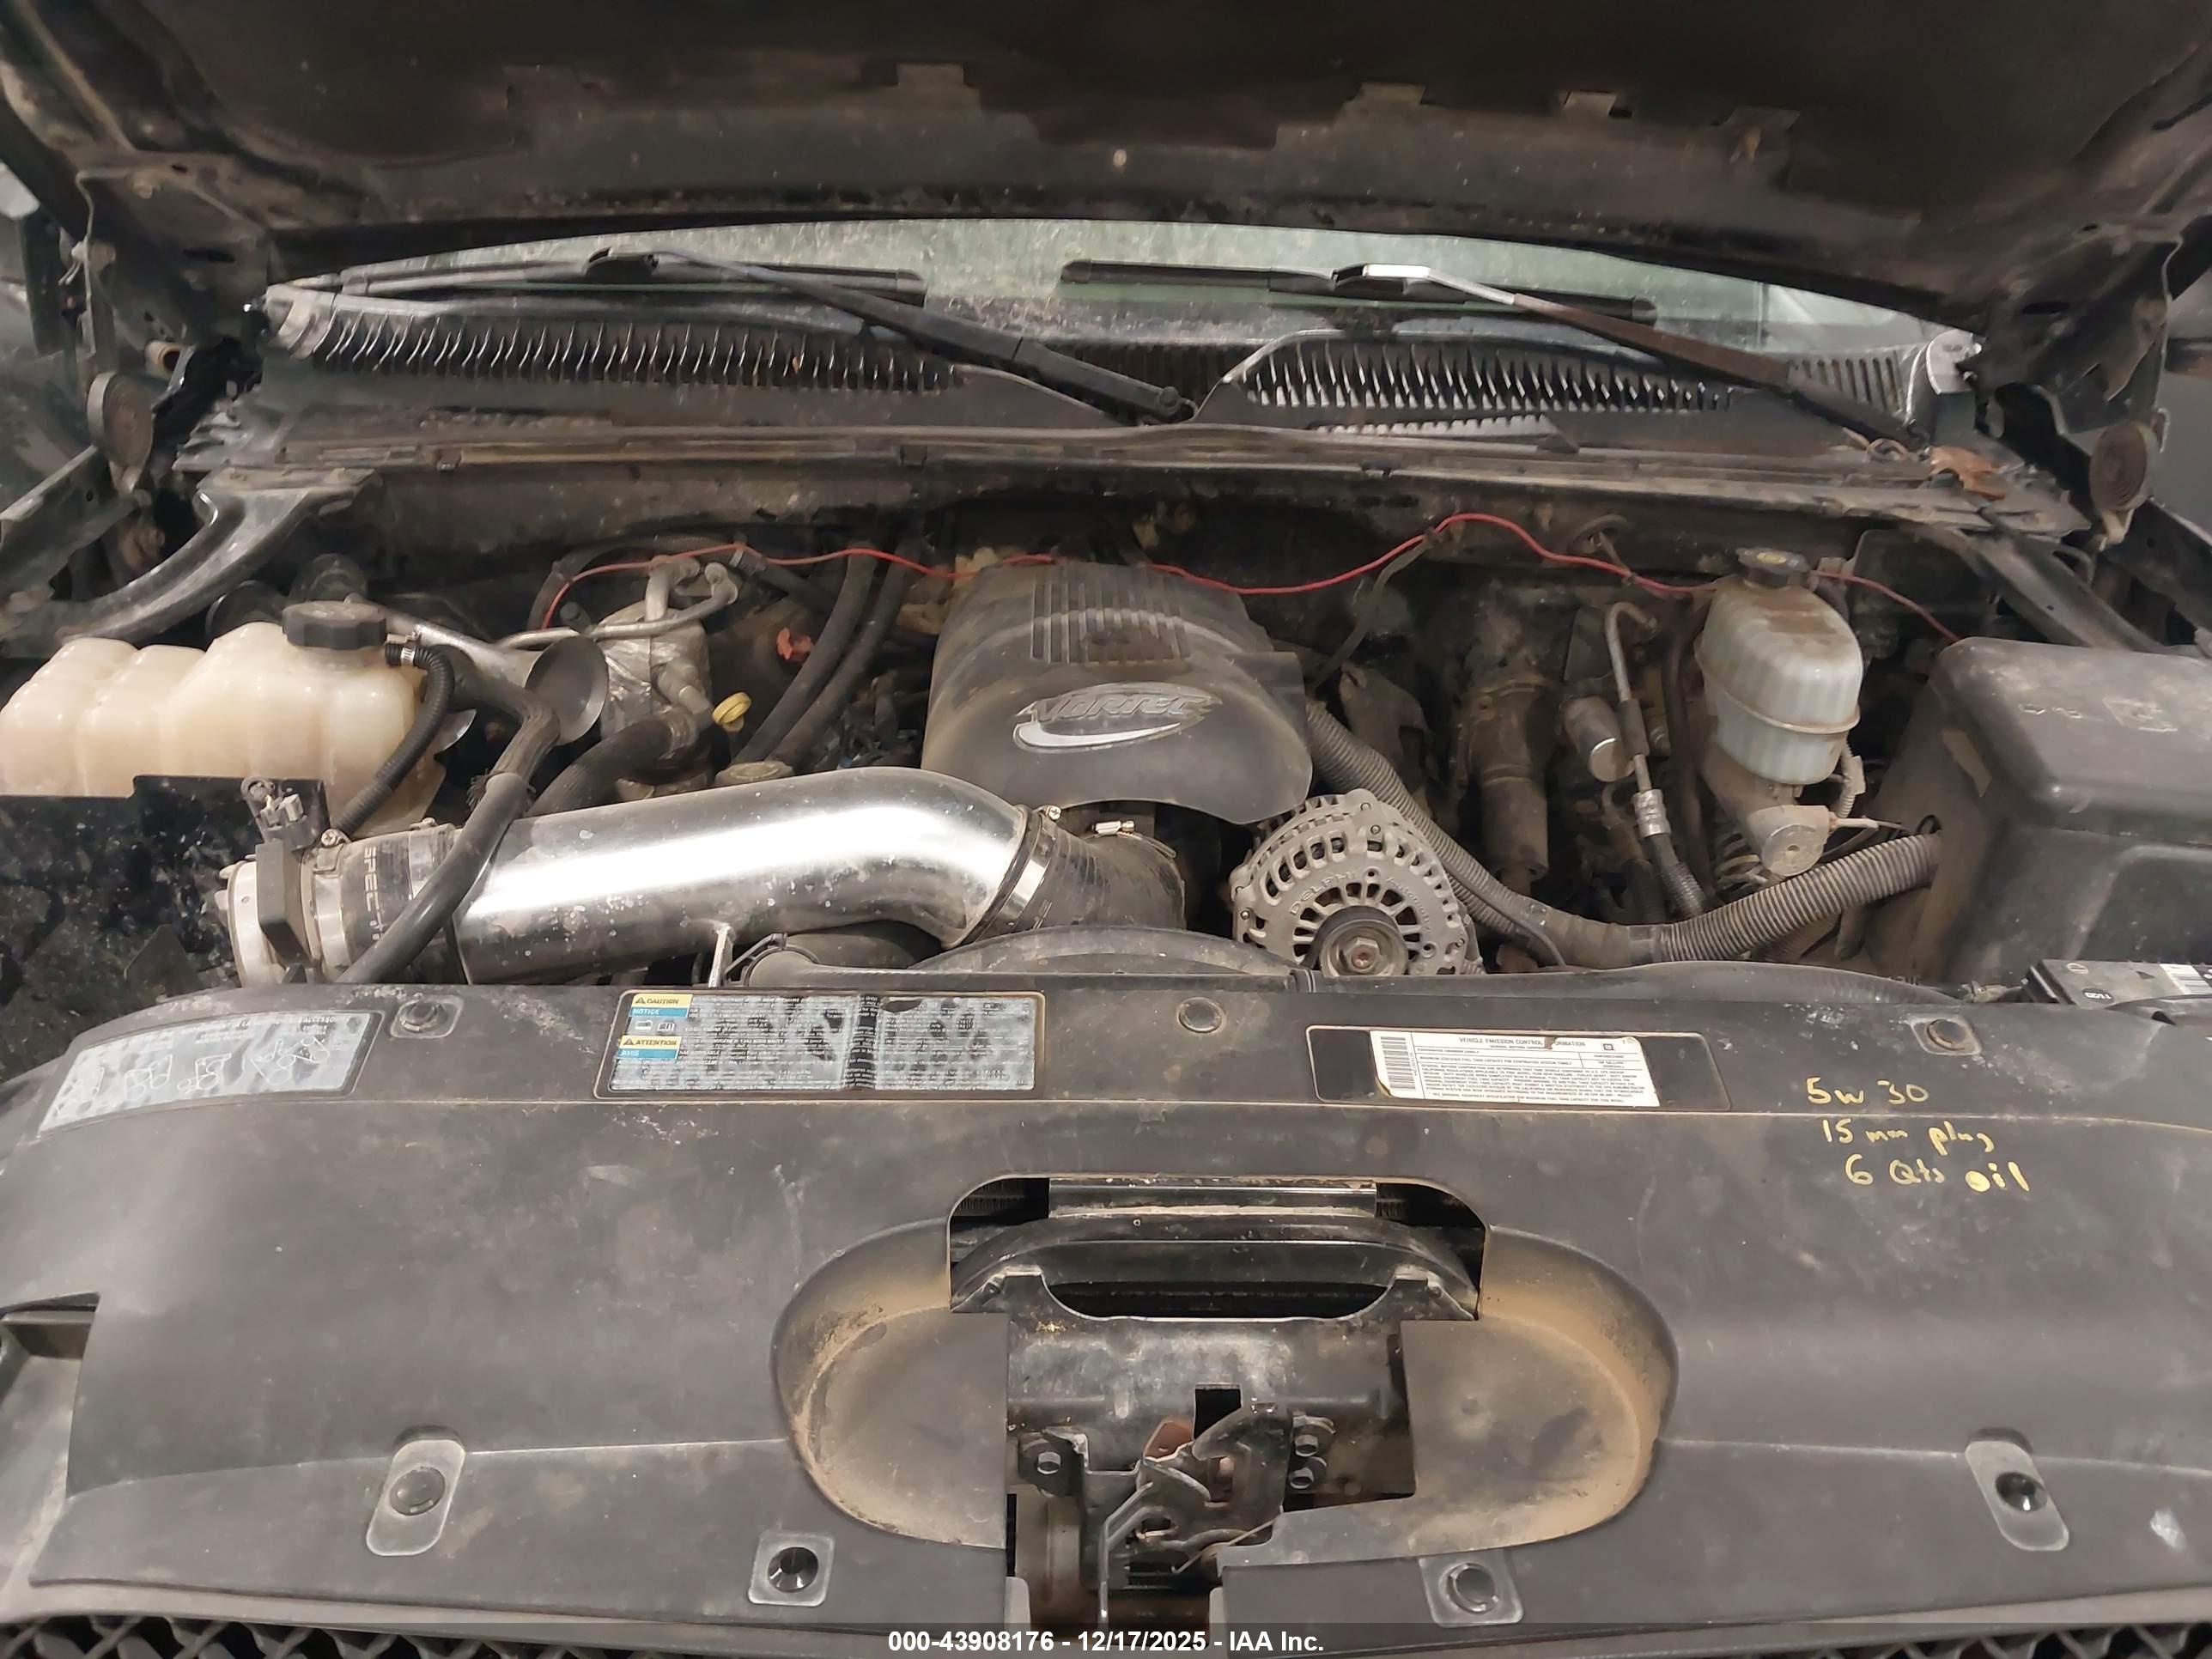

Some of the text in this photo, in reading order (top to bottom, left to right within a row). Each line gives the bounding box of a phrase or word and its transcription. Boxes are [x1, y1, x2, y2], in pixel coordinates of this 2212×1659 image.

[1030, 691, 1211, 724] VORTEC
[1877, 1079, 1929, 1105] 30
[1821, 1118, 1854, 1144] 15
[1844, 1153, 1874, 1186] 6
[1965, 1161, 2031, 1193] oil
